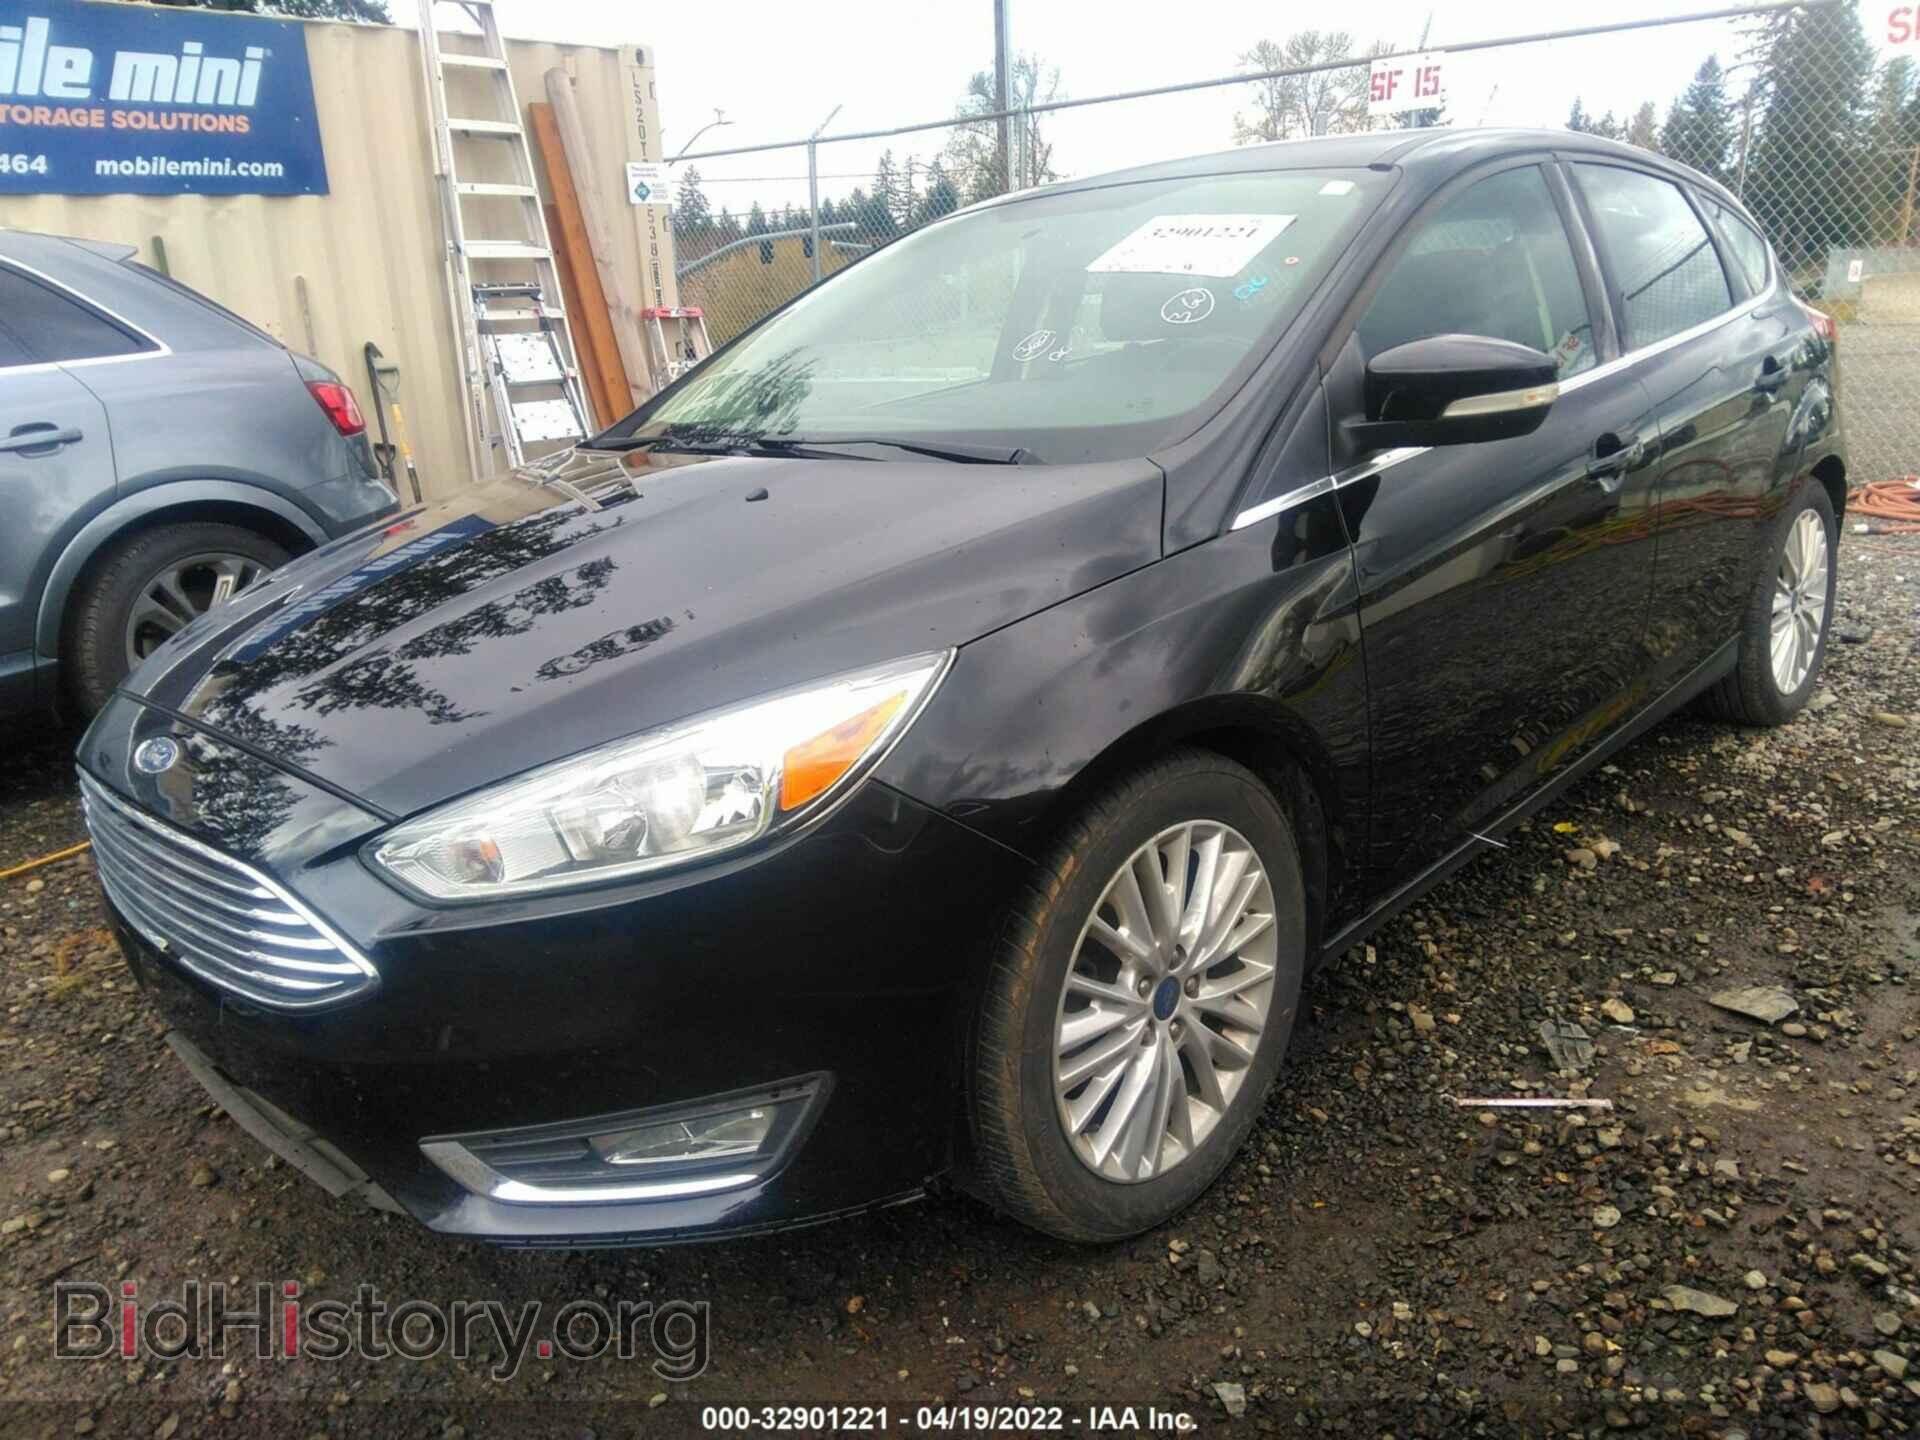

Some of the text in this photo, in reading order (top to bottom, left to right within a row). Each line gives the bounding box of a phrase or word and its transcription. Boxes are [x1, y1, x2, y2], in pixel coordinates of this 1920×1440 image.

[109, 42, 264, 106] mini
[1370, 65, 1441, 102] SF 15
[112, 110, 250, 132] SOLUTIONS
[95, 155, 284, 177] mobilemini.com
[632, 71, 649, 162] LS20T
[647, 203, 658, 257] 538
